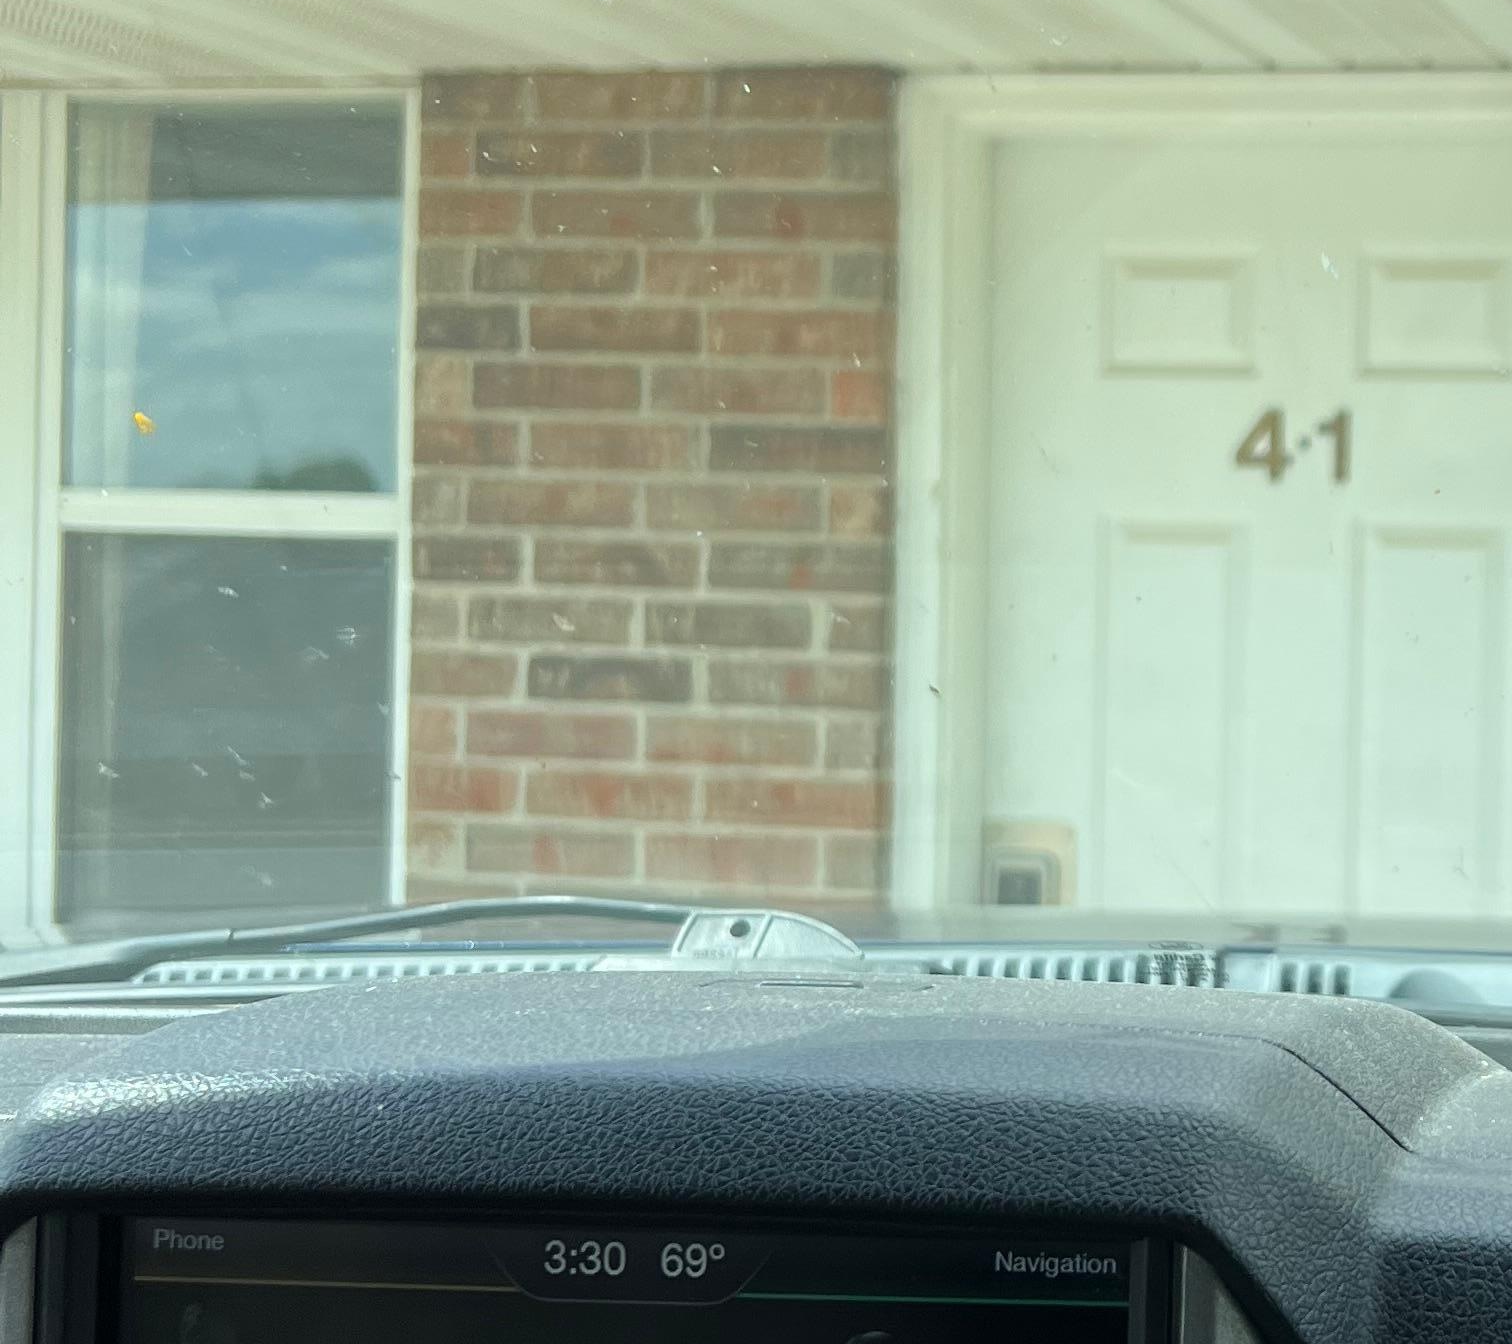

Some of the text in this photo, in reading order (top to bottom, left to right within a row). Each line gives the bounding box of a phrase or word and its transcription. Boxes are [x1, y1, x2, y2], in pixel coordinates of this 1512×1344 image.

[1233, 406, 1352, 484] 41
[153, 1229, 225, 1252] Phone
[543, 1240, 626, 1276] 3:30
[994, 1250, 1117, 1278] Navigation
